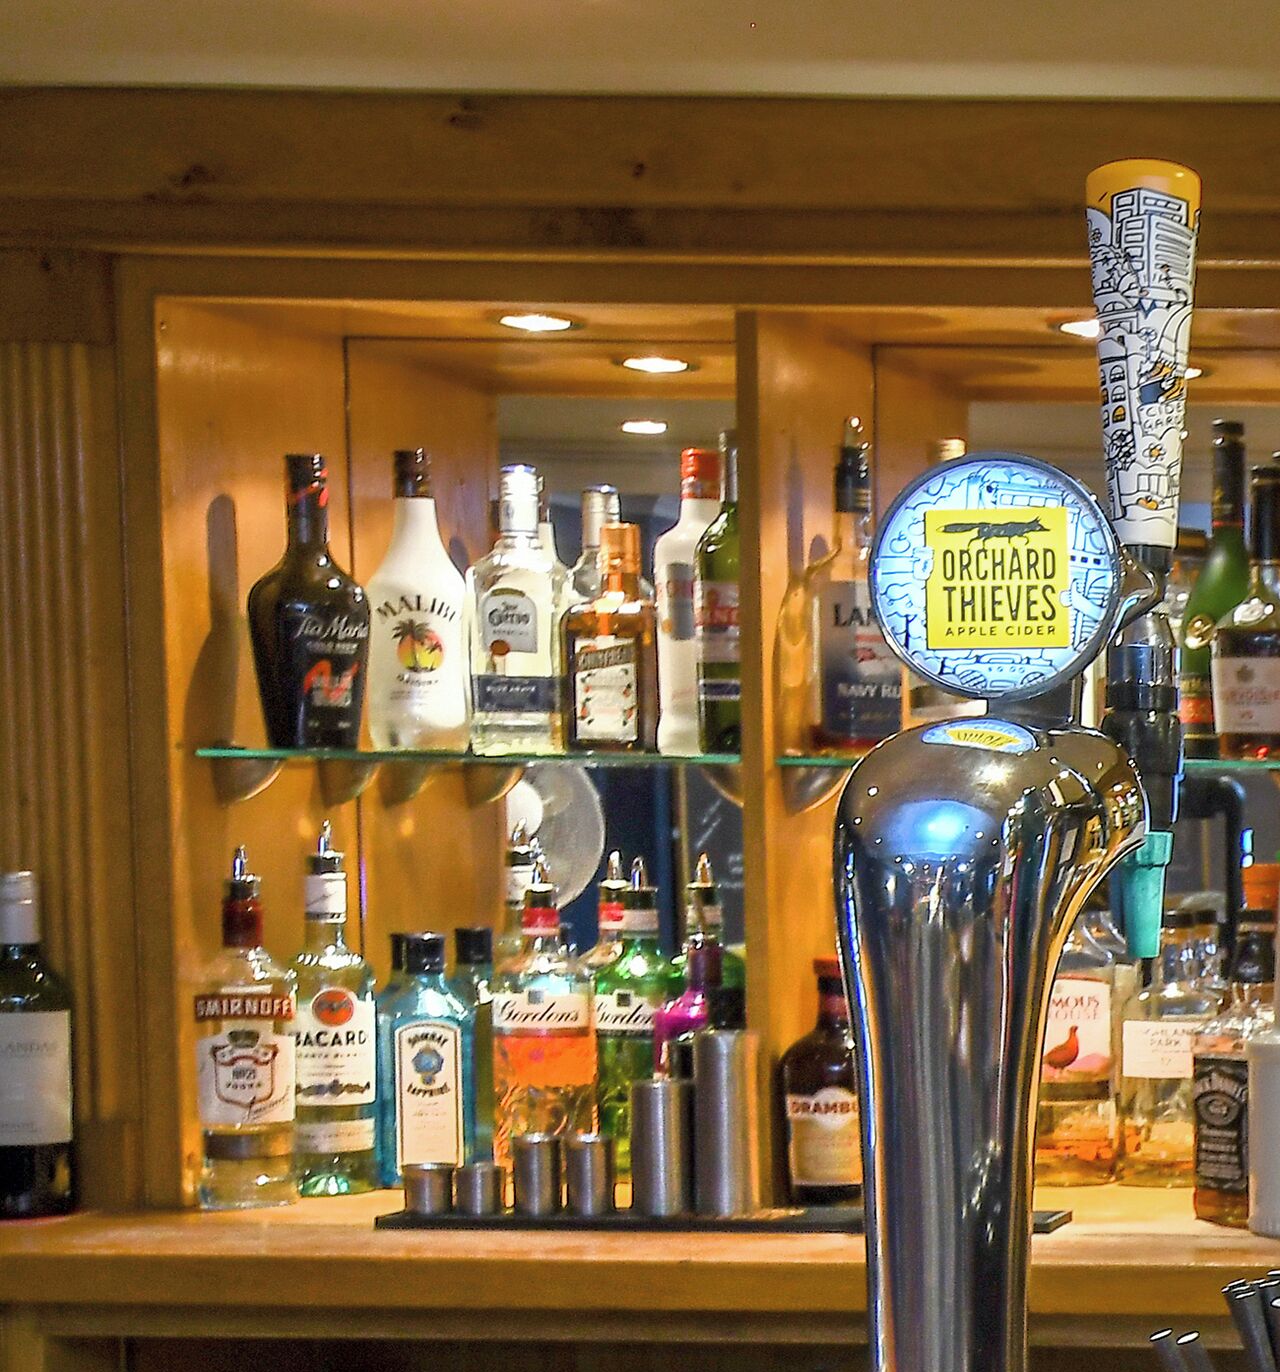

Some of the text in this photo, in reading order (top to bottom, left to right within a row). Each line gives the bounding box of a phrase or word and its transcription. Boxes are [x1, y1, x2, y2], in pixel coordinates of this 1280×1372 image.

[1145, 401, 1182, 416] CIDE
[942, 548, 1057, 581] ORCHARD
[942, 584, 1057, 622] THIEVES
[945, 625, 1056, 637] APPLE CIDER
[195, 998, 293, 1019] SMIRNOFF
[498, 999, 581, 1023] Gordon's
[1050, 995, 1101, 1009] MOUS
[596, 1001, 655, 1024] Gordon
[1048, 1009, 1100, 1021] OUSE
[293, 1029, 370, 1048] BACARD
